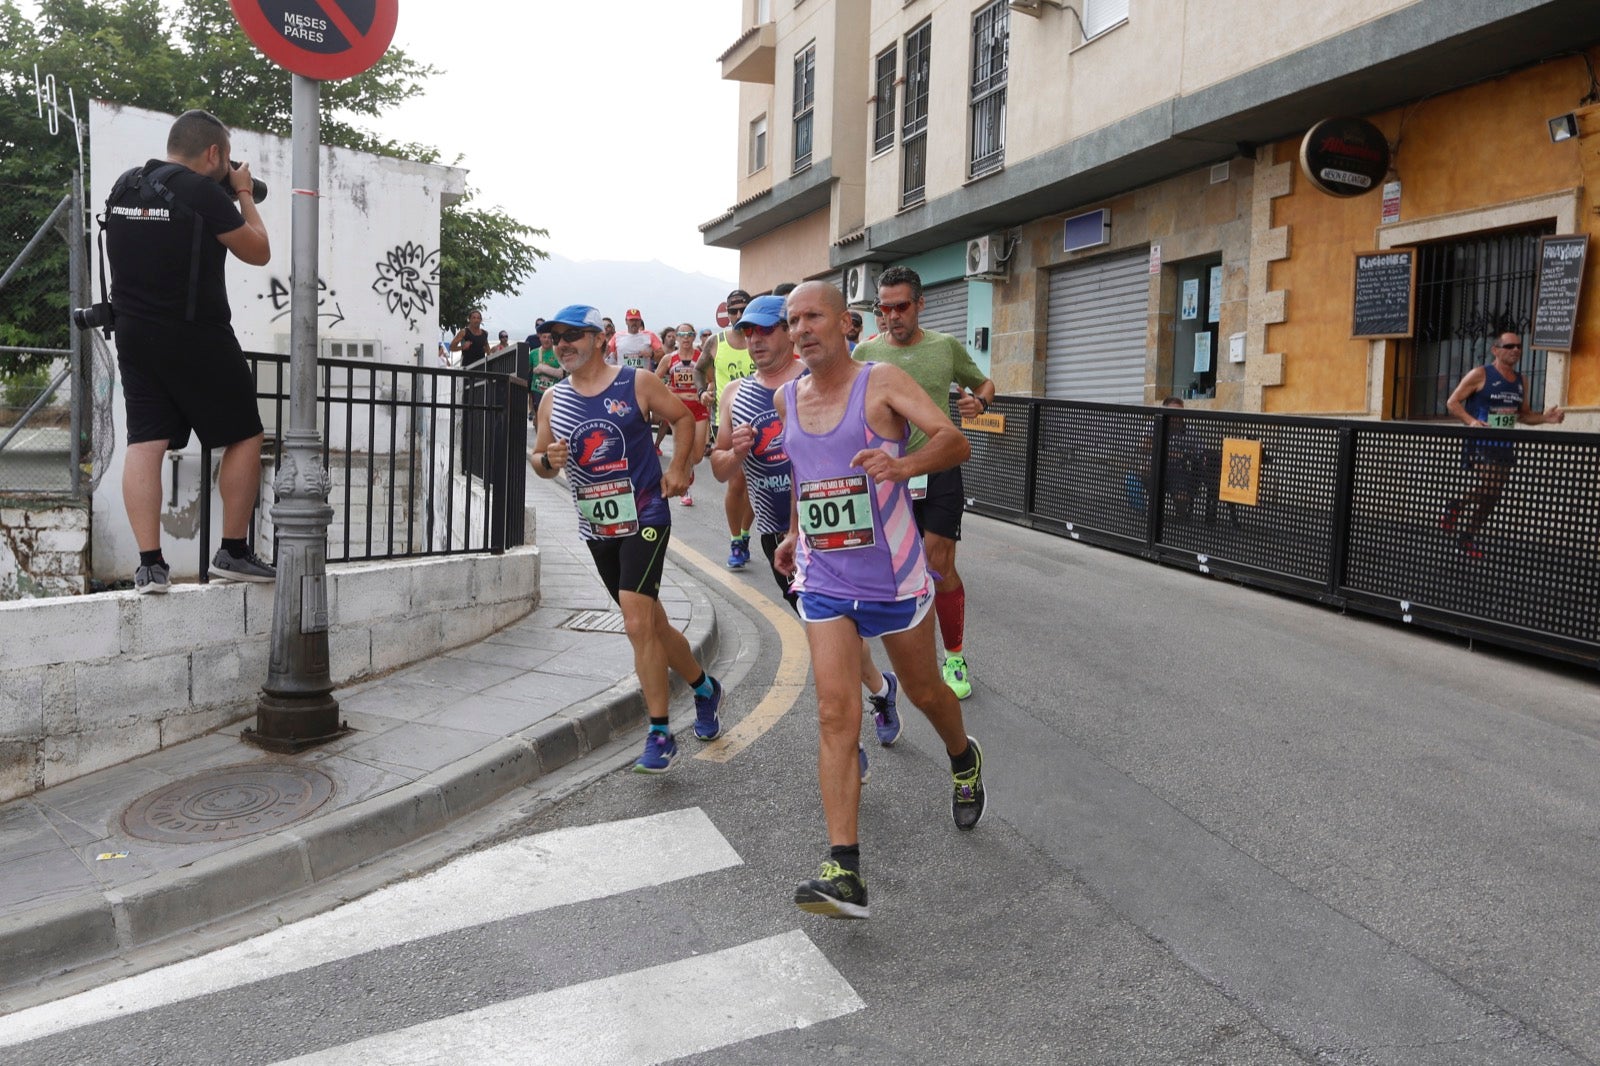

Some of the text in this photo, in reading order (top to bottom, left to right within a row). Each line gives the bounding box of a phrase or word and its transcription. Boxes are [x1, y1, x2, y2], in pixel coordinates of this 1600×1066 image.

[284, 11, 327, 30] MESES
[284, 25, 324, 43] PARES
[627, 358, 642, 366] 678
[678, 373, 693, 382] 201
[1495, 415, 1515, 427] 195
[574, 422, 598, 441] HUELLAS
[839, 479, 845, 488] DE
[592, 499, 619, 521] 40
[808, 498, 856, 529] 901
